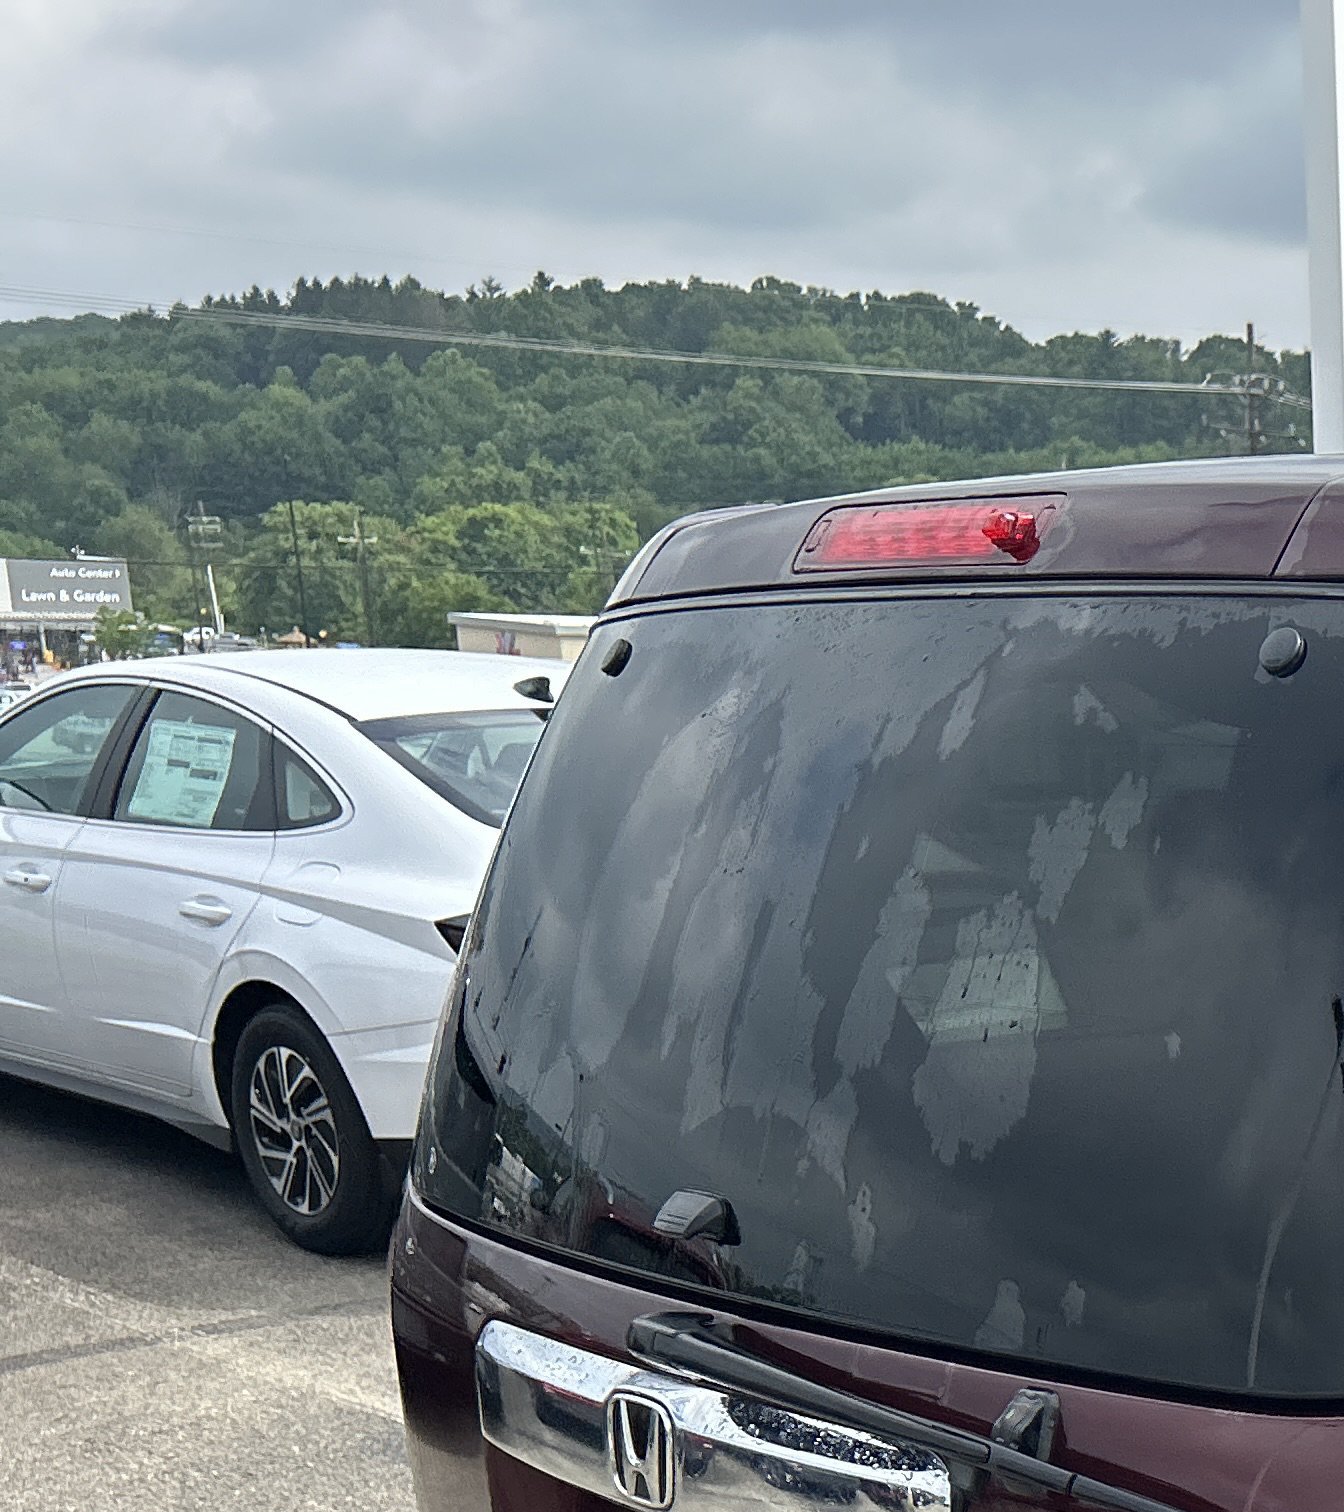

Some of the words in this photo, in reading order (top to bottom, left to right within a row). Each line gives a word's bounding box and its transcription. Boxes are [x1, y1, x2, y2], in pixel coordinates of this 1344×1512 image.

[50, 567, 76, 579] Auto
[78, 567, 113, 579] Center
[22, 589, 56, 602] Lawn
[60, 589, 70, 602] &
[73, 589, 120, 603] Garden
